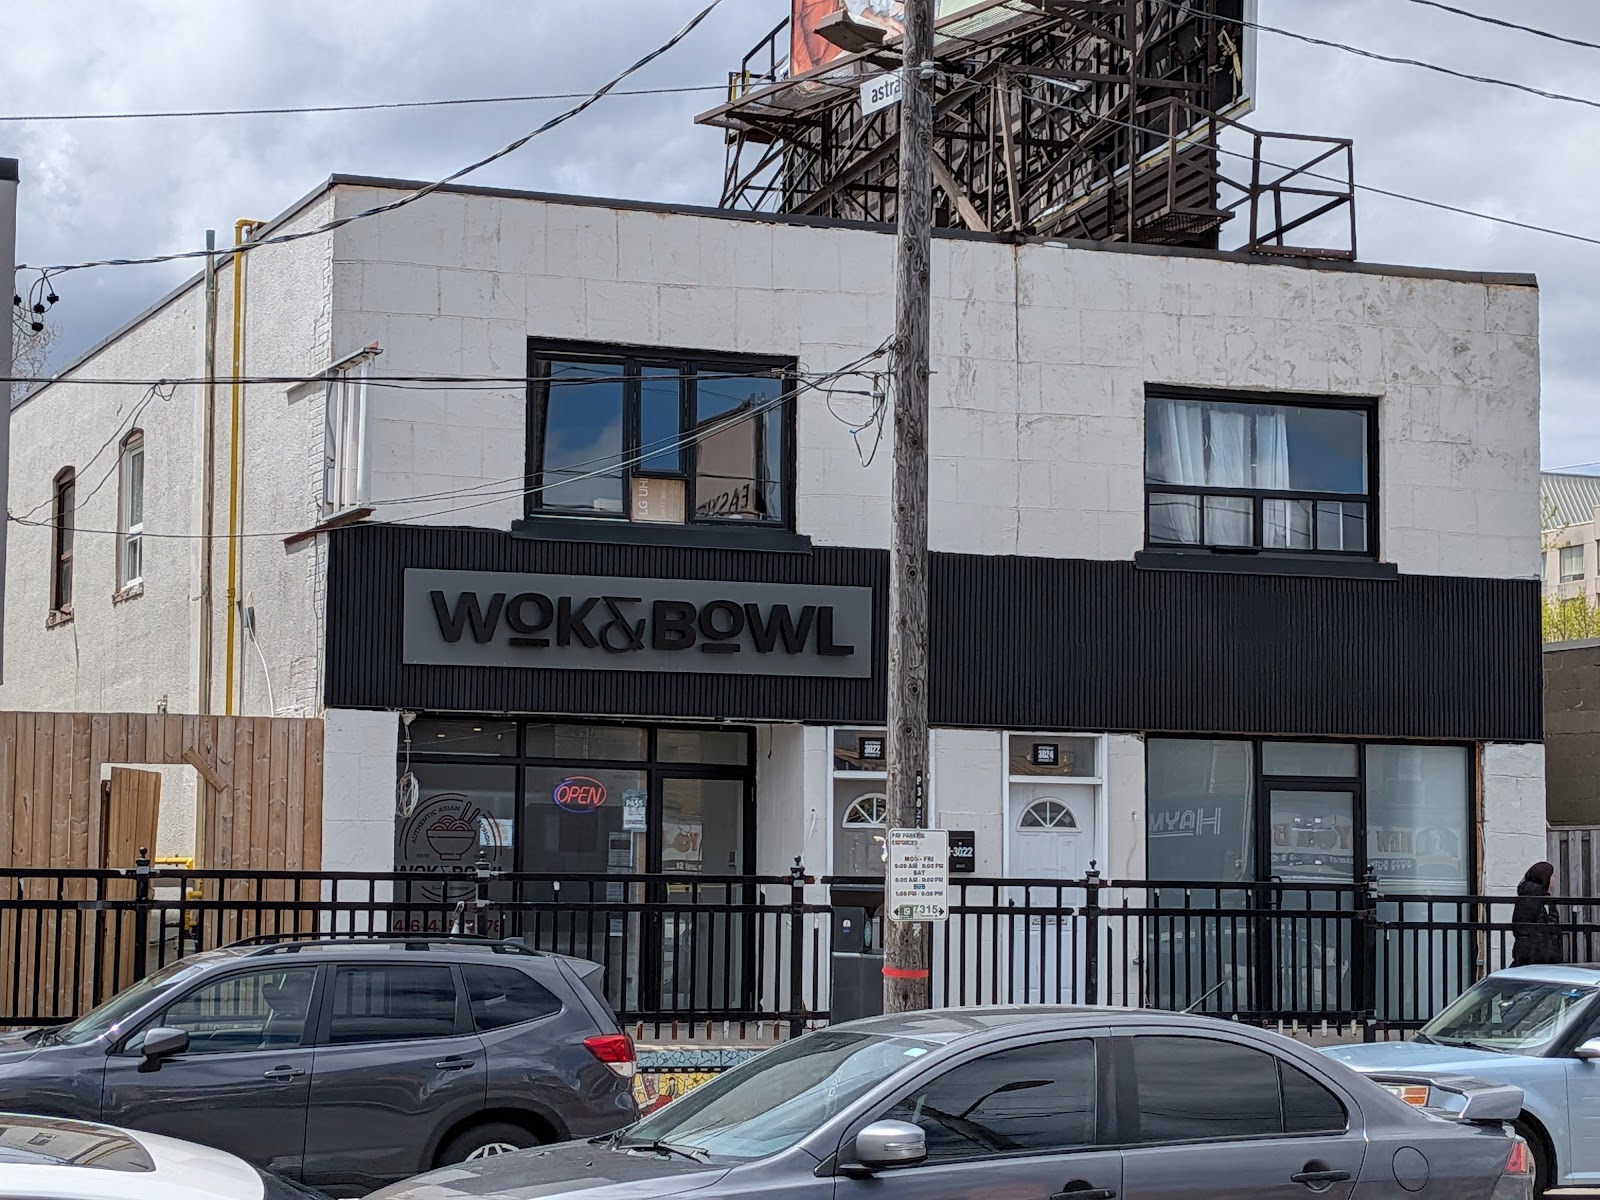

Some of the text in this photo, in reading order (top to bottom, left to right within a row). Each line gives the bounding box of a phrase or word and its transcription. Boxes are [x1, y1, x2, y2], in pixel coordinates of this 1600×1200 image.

[638, 500, 648, 516] LG
[557, 785, 602, 805] OPEN
[625, 798, 644, 807] PASS
[411, 808, 437, 844] AUTHENTIC
[438, 805, 461, 813] ASIAN
[913, 904, 938, 914] 7315
